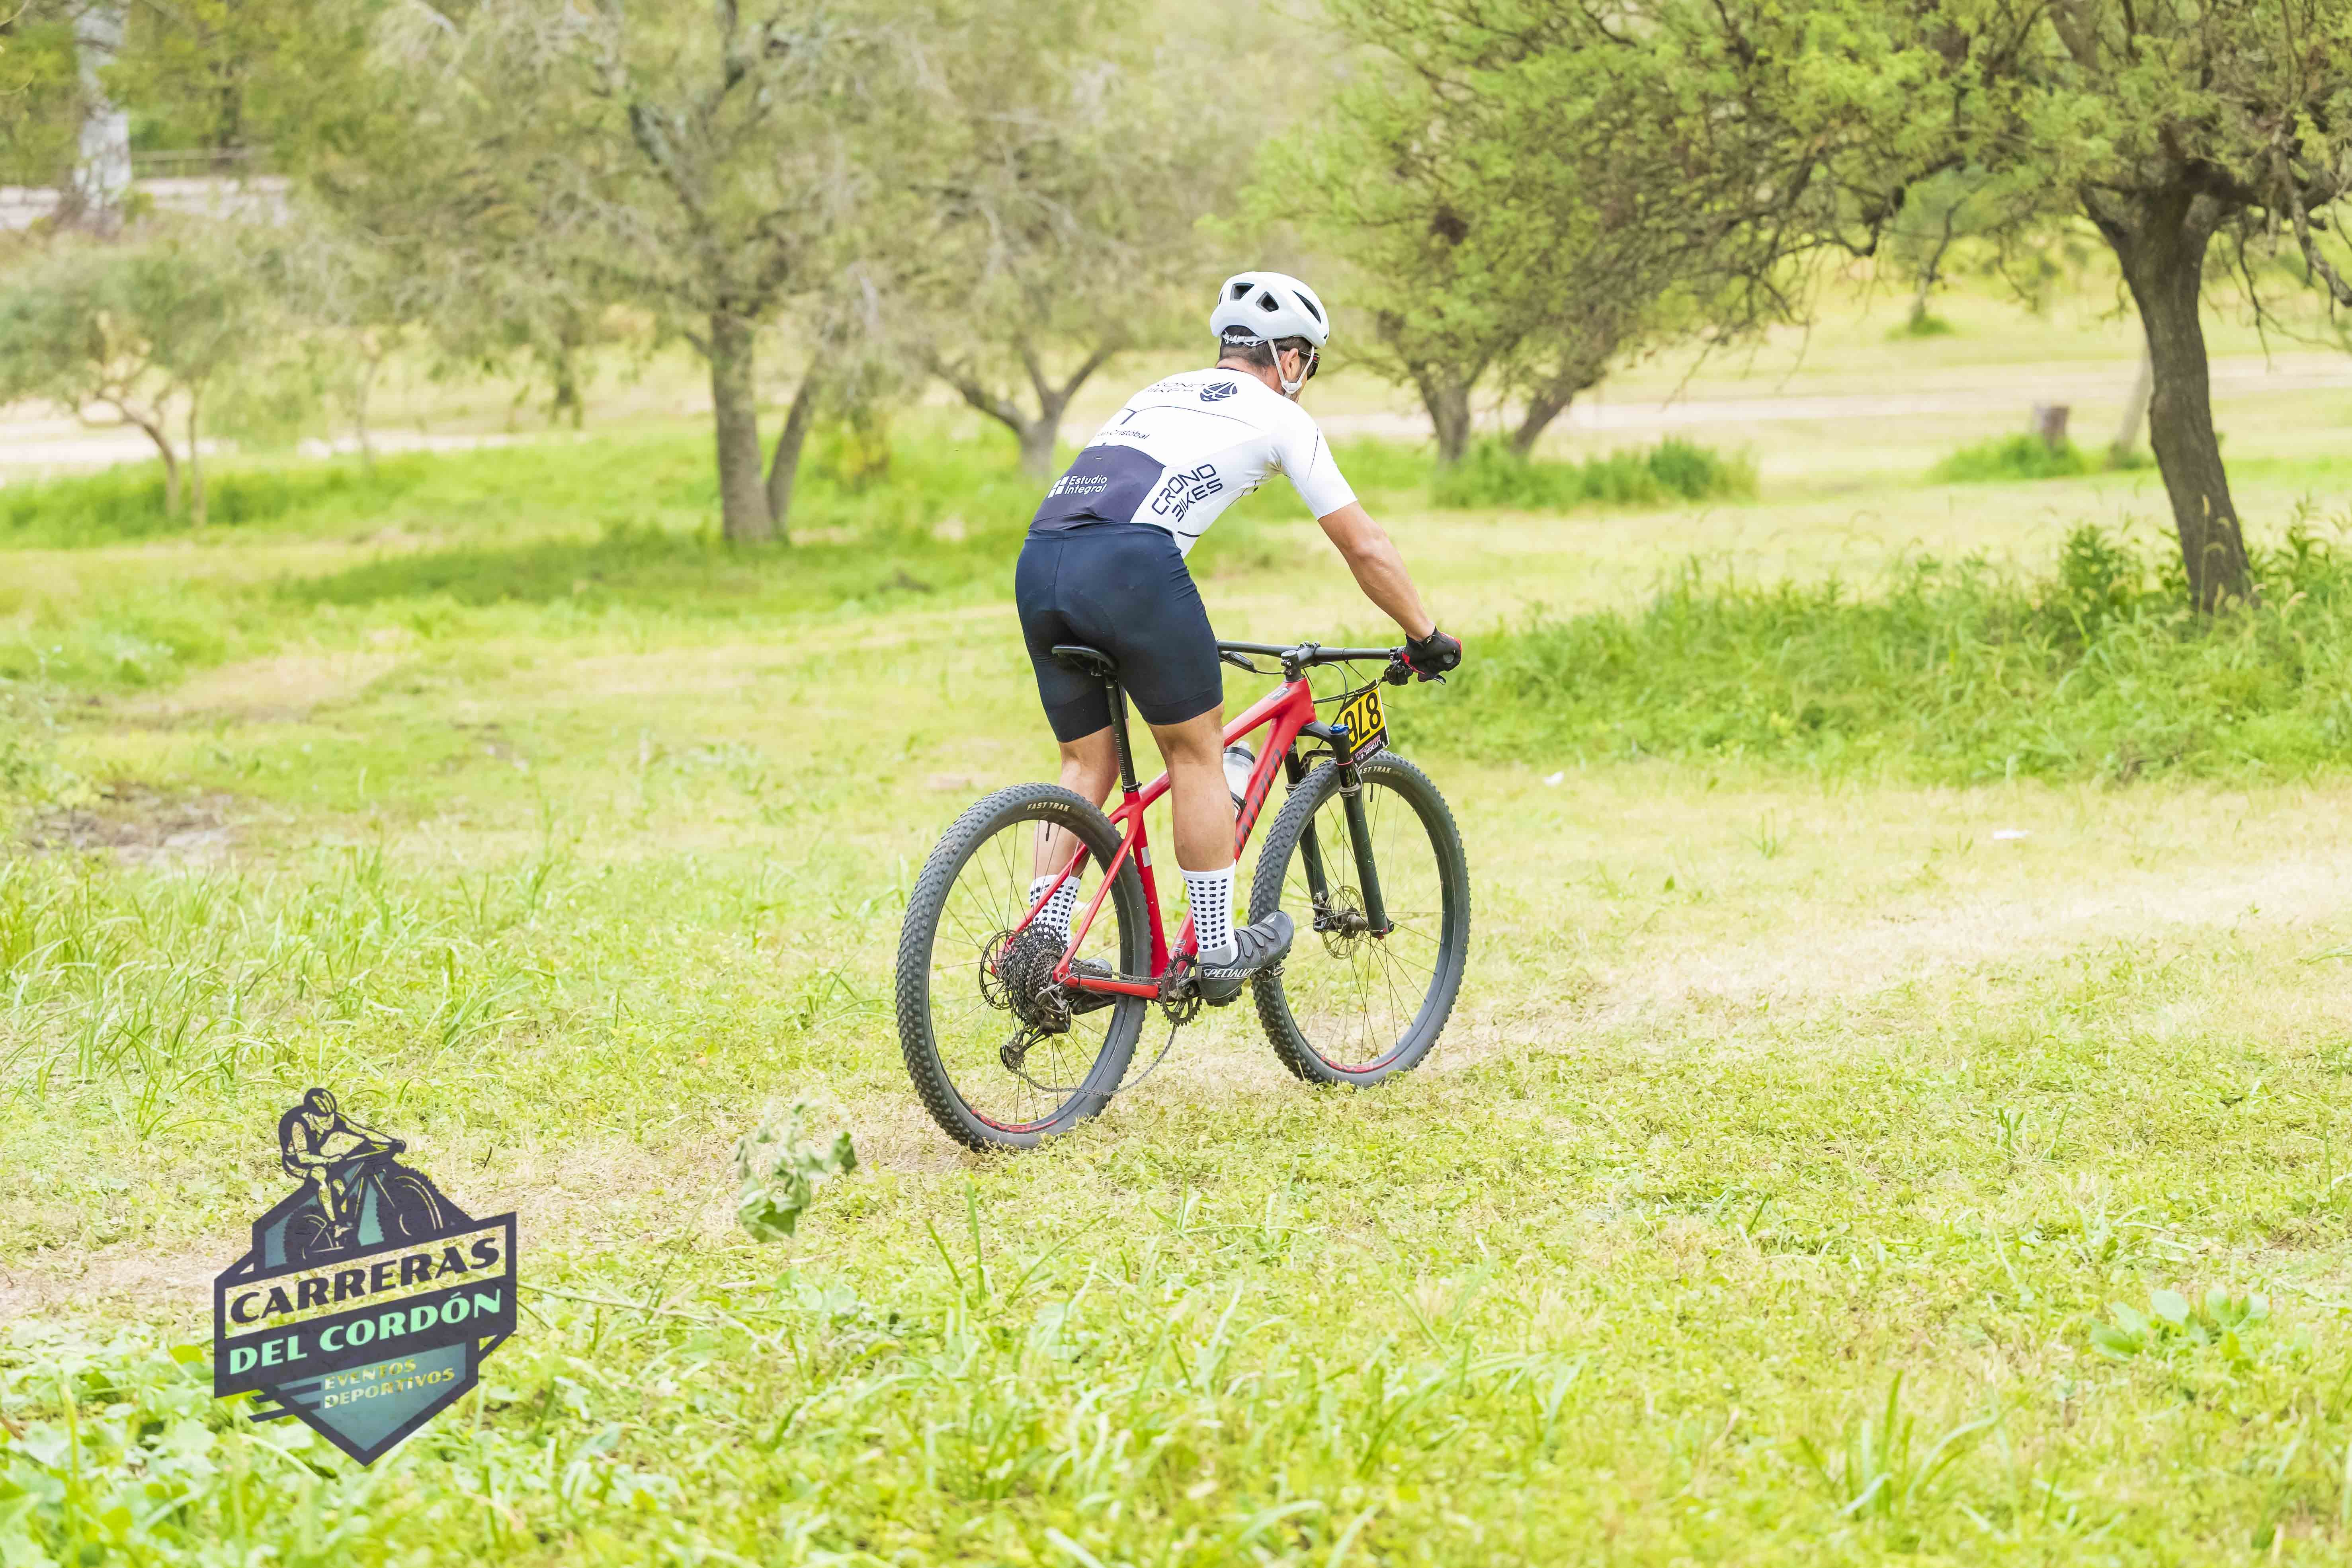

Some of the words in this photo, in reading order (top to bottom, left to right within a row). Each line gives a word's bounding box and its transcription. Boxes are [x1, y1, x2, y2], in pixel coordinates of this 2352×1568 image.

[1069, 475, 1107, 485] Estudio
[1064, 484, 1107, 495] Integral
[1152, 464, 1216, 515] CRONO
[1026, 802, 1048, 811] FAST
[1049, 802, 1070, 812] TRAK
